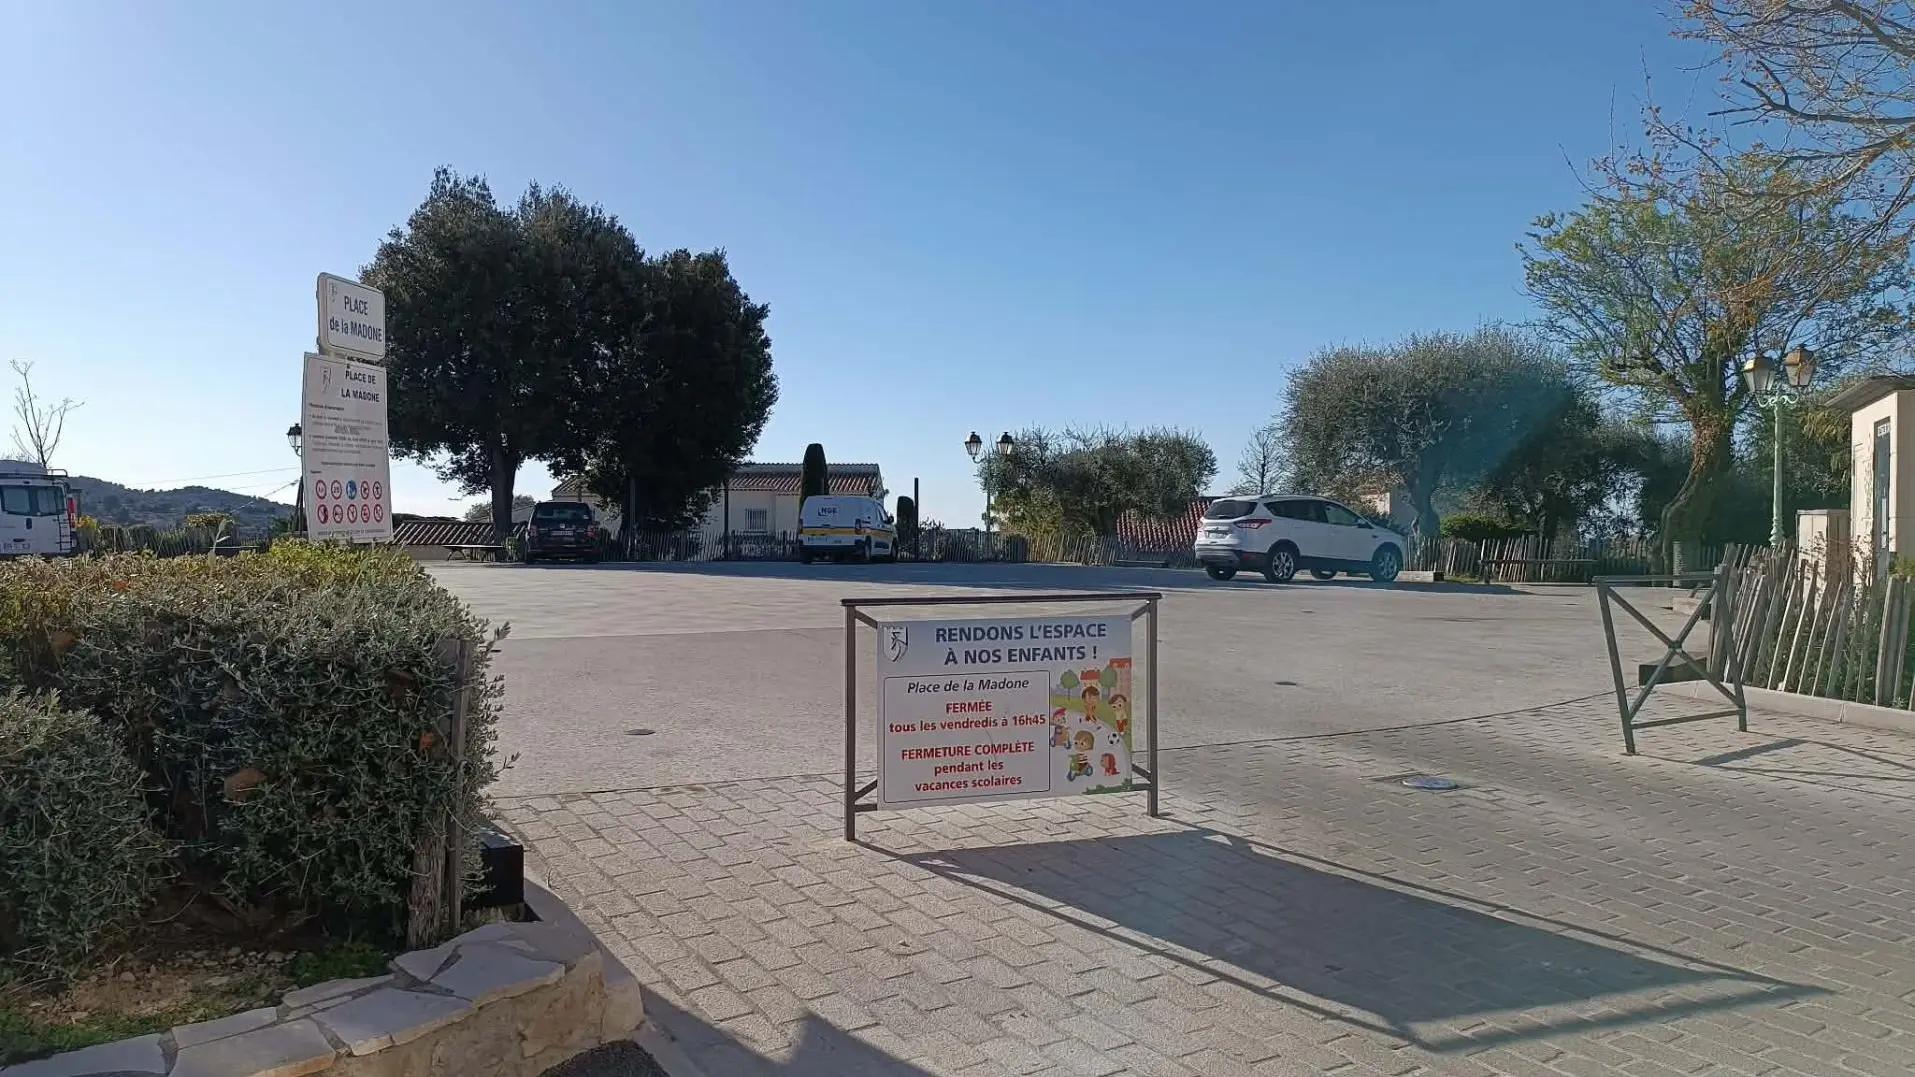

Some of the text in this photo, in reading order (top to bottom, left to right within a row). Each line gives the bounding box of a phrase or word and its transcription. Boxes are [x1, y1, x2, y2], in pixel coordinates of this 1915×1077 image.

[344, 296, 368, 315] PLACE
[330, 317, 382, 342] de la MADONE
[346, 370, 376, 384] PLACE DE
[341, 388, 380, 402] LA MADONE
[936, 623, 1108, 643] RENDONS L'ESPACE
[944, 646, 1097, 665] À NOS ENFANTS !
[908, 678, 1029, 693] Place de la Madone
[946, 699, 992, 713] FERMÉE
[889, 714, 1046, 732] tous les vendredis à 16h45
[902, 741, 1034, 760] FERMETURE COMPLÈTE
[934, 761, 1003, 776] pendant les
[916, 776, 1022, 792] vacances scolaires
